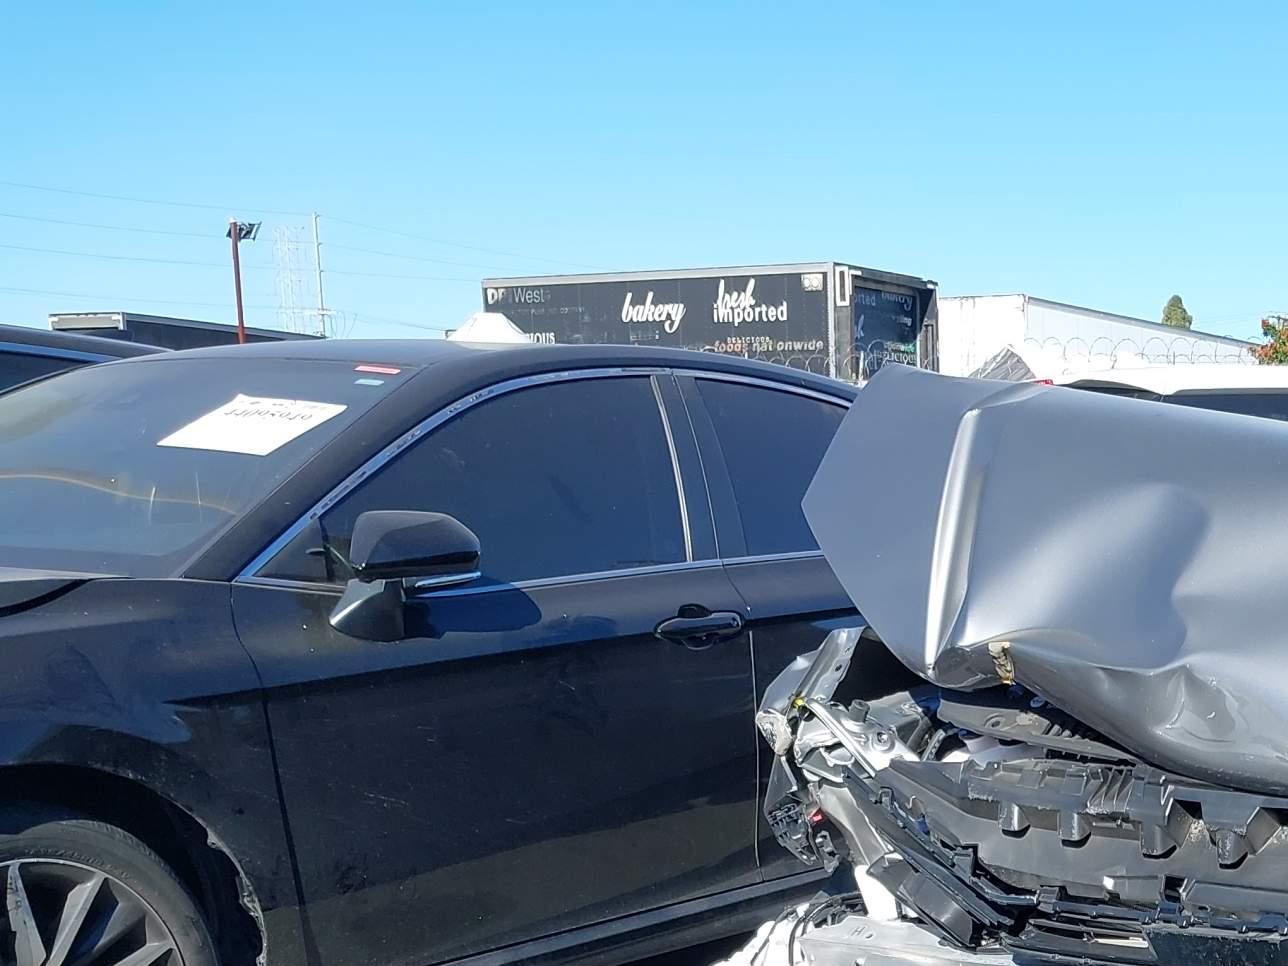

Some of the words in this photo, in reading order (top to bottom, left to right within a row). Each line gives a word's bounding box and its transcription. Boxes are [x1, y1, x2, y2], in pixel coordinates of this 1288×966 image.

[513, 287, 545, 304] West
[621, 291, 687, 333] bakery
[712, 299, 789, 327] imported
